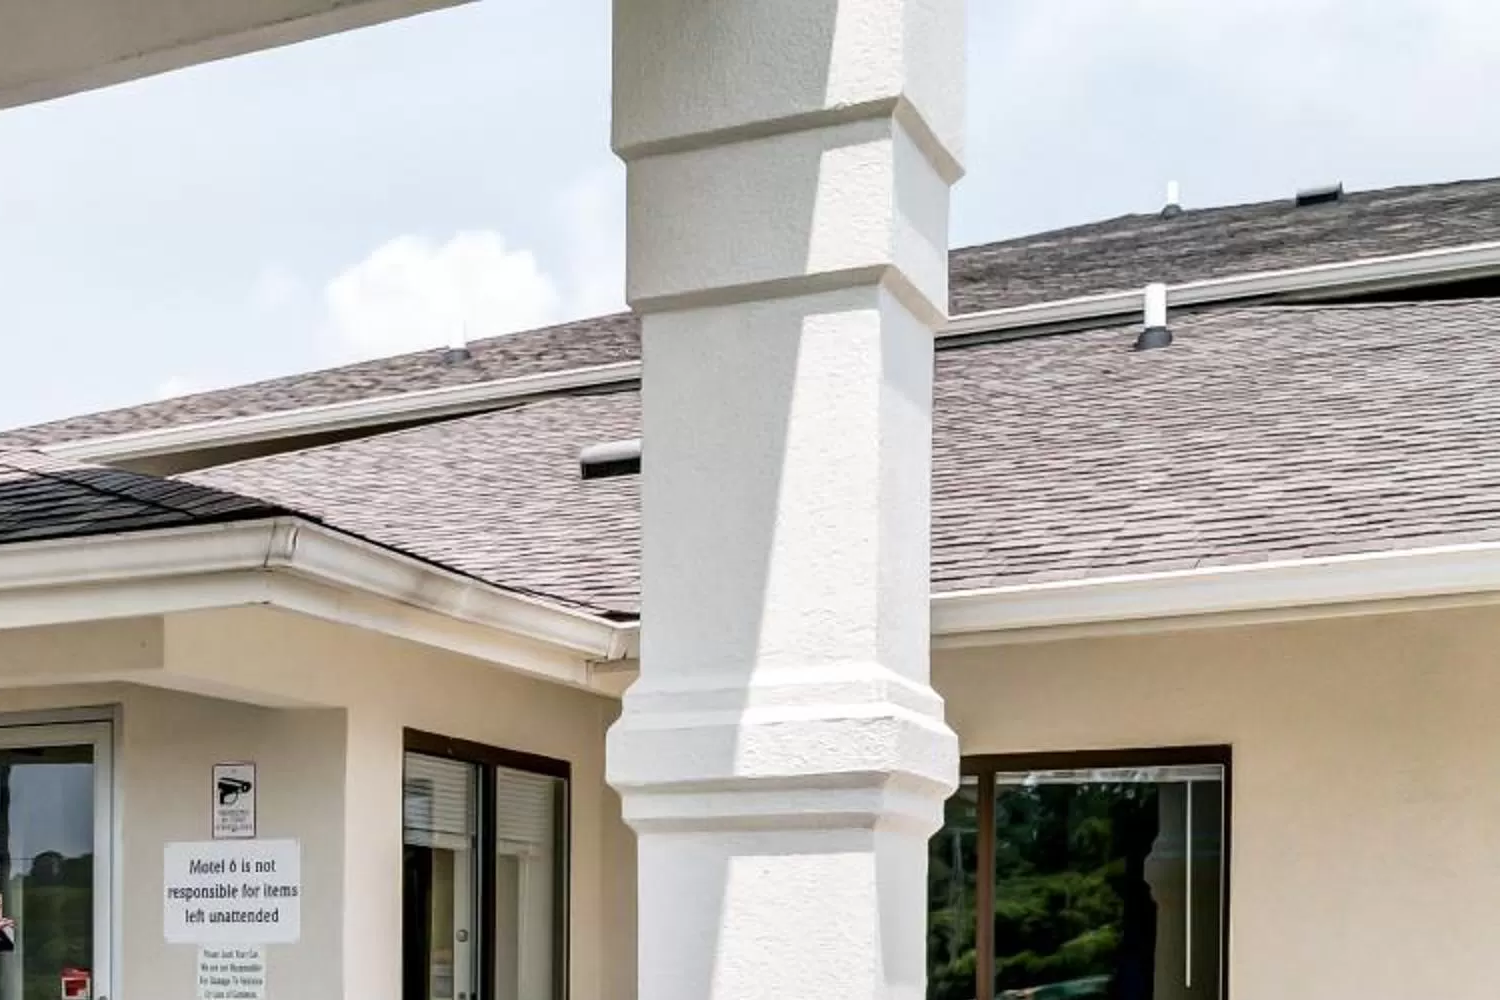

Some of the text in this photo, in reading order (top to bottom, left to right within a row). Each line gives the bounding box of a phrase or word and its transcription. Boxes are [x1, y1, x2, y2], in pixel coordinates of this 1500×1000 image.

[189, 858, 276, 874] Motel 6 is not
[167, 883, 298, 902] responsible for items
[185, 908, 279, 923] left unattended
